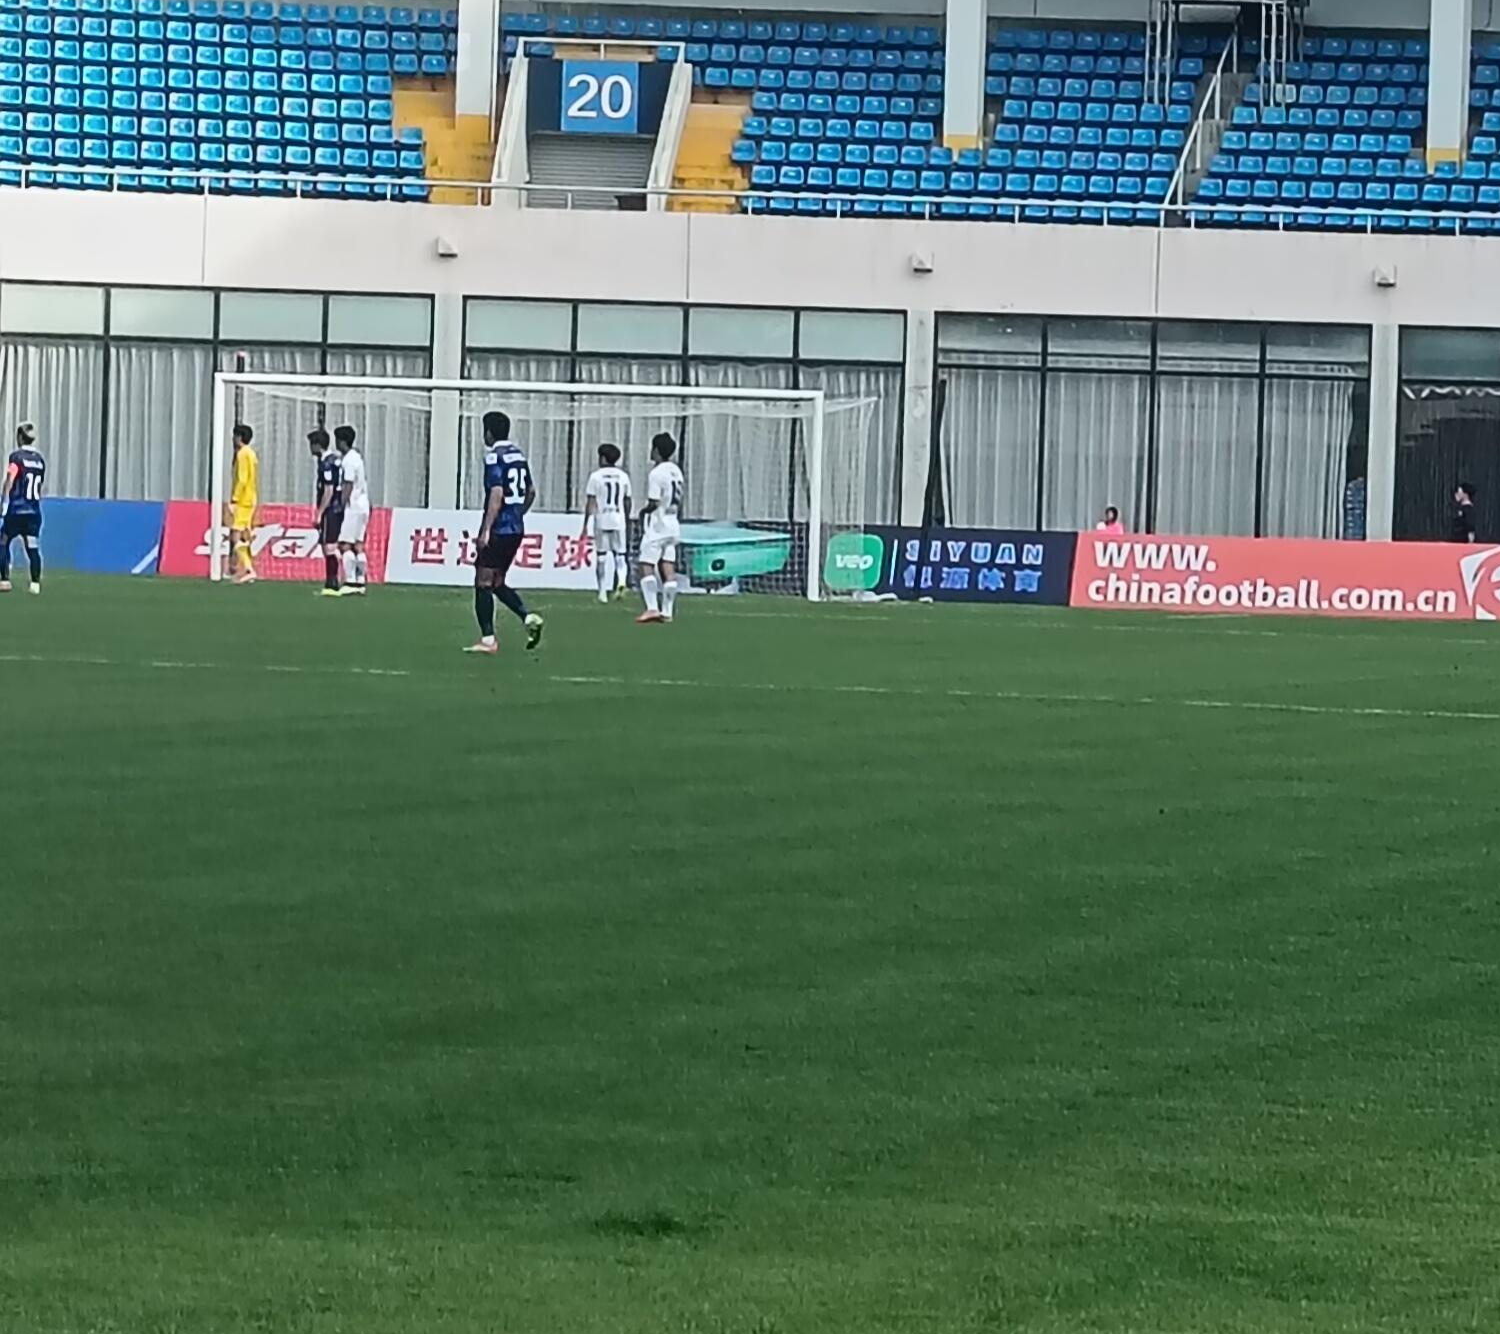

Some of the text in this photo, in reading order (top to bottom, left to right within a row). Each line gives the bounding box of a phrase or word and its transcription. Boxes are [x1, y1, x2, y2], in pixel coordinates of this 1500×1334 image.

[567, 73, 633, 119] 20
[604, 481, 620, 506] 11
[1087, 573, 1457, 614] chinafootball.com.cn
